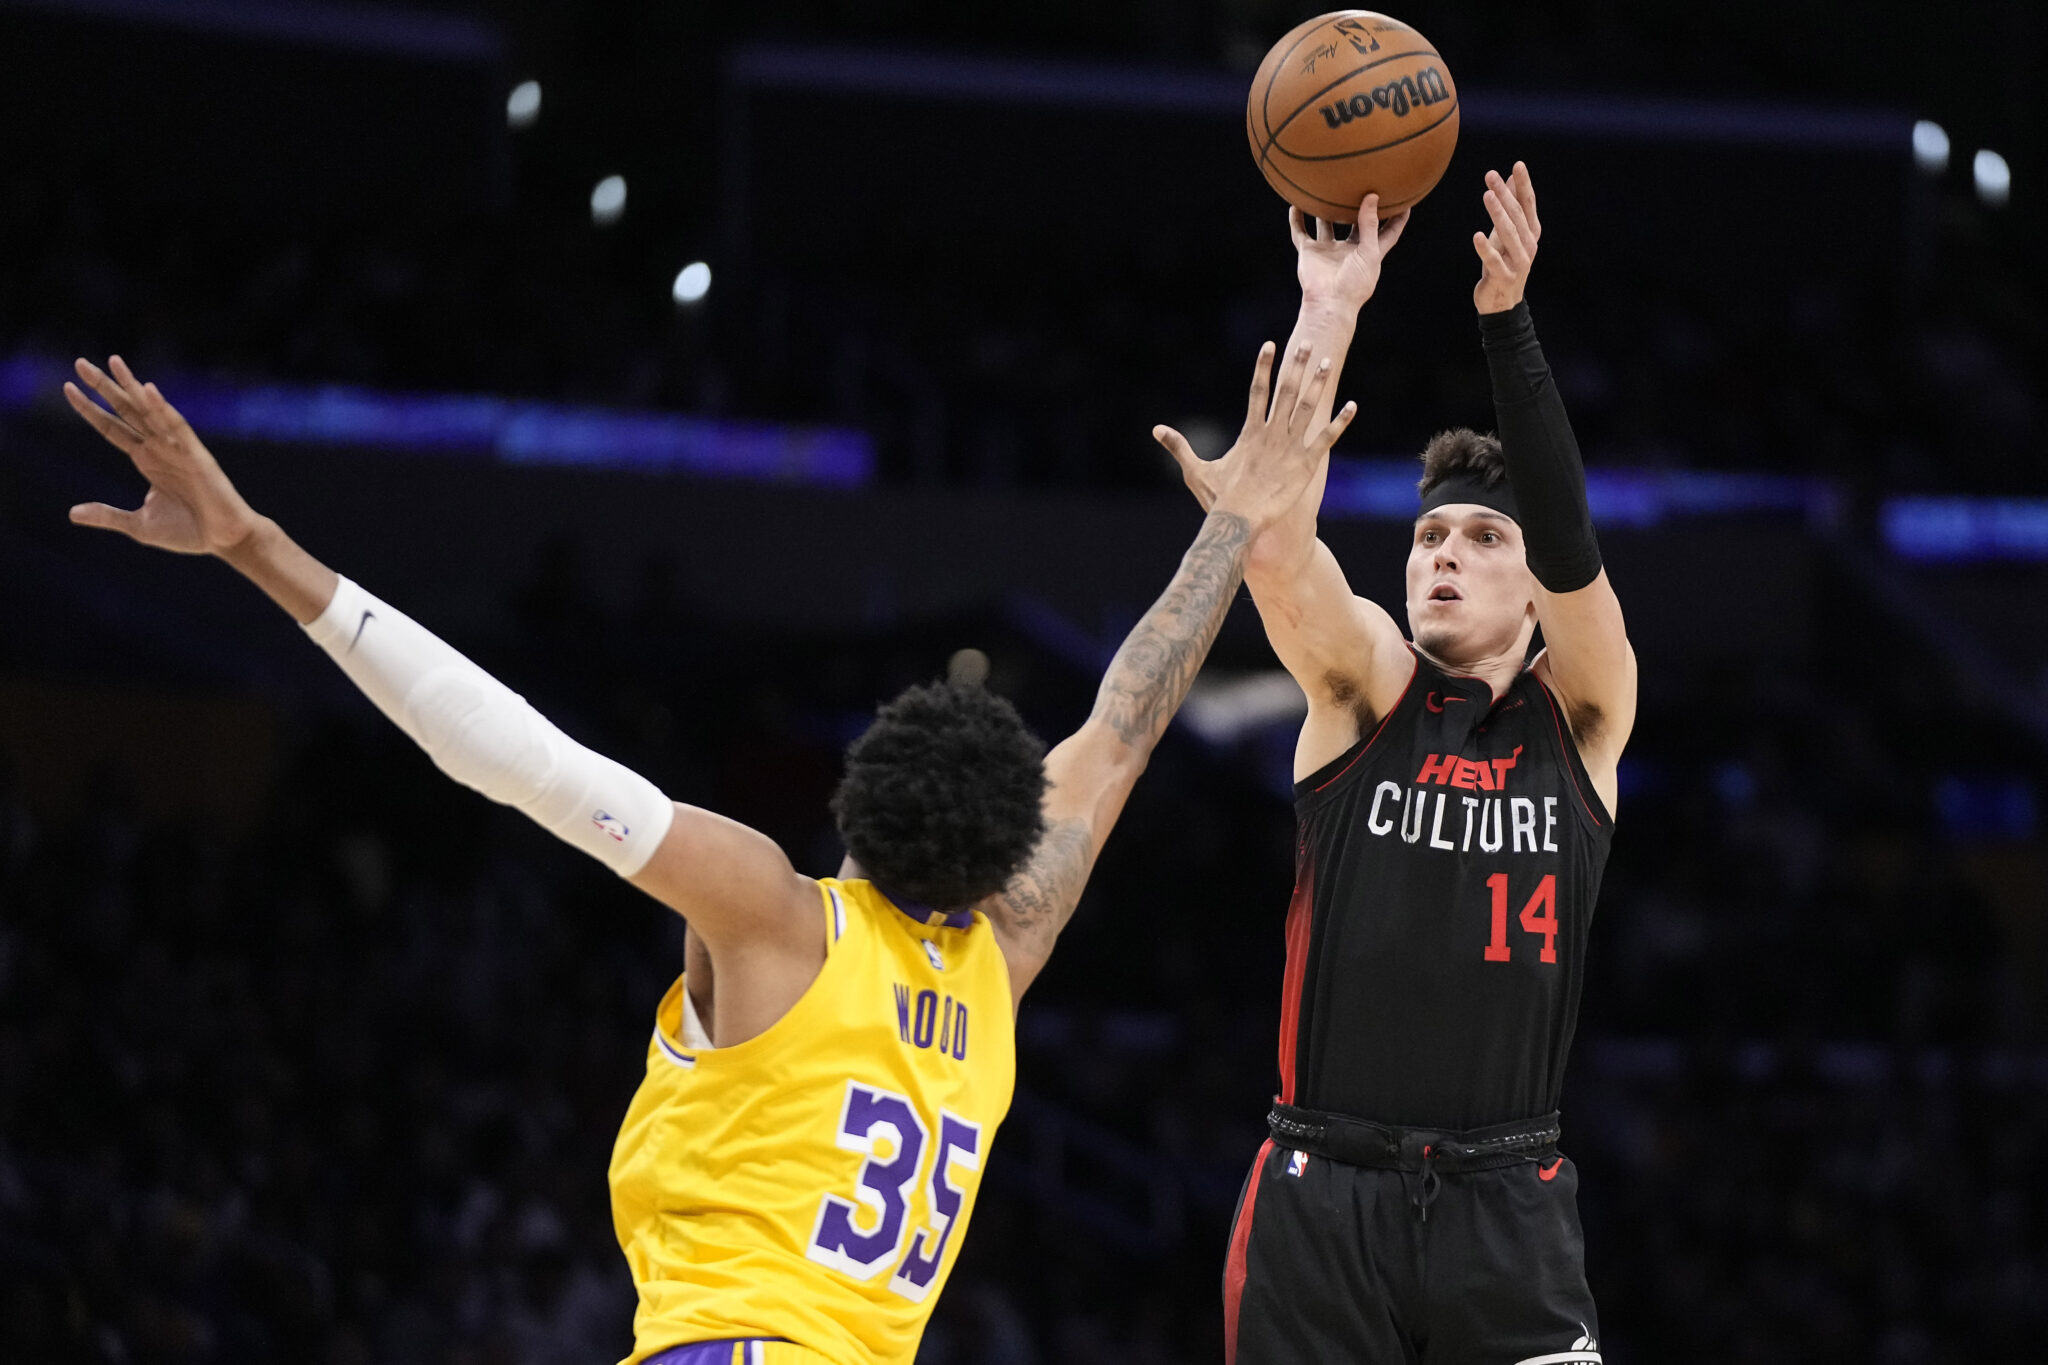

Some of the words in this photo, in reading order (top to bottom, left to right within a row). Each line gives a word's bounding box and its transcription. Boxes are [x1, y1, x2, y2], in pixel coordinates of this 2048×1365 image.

[1319, 66, 1450, 129] Wilson
[1416, 744, 1524, 792] HEAT
[1367, 780, 1558, 853] CULTURE
[1483, 872, 1558, 963] 14
[893, 982, 968, 1061] WOOD
[806, 1078, 981, 1304] 35
